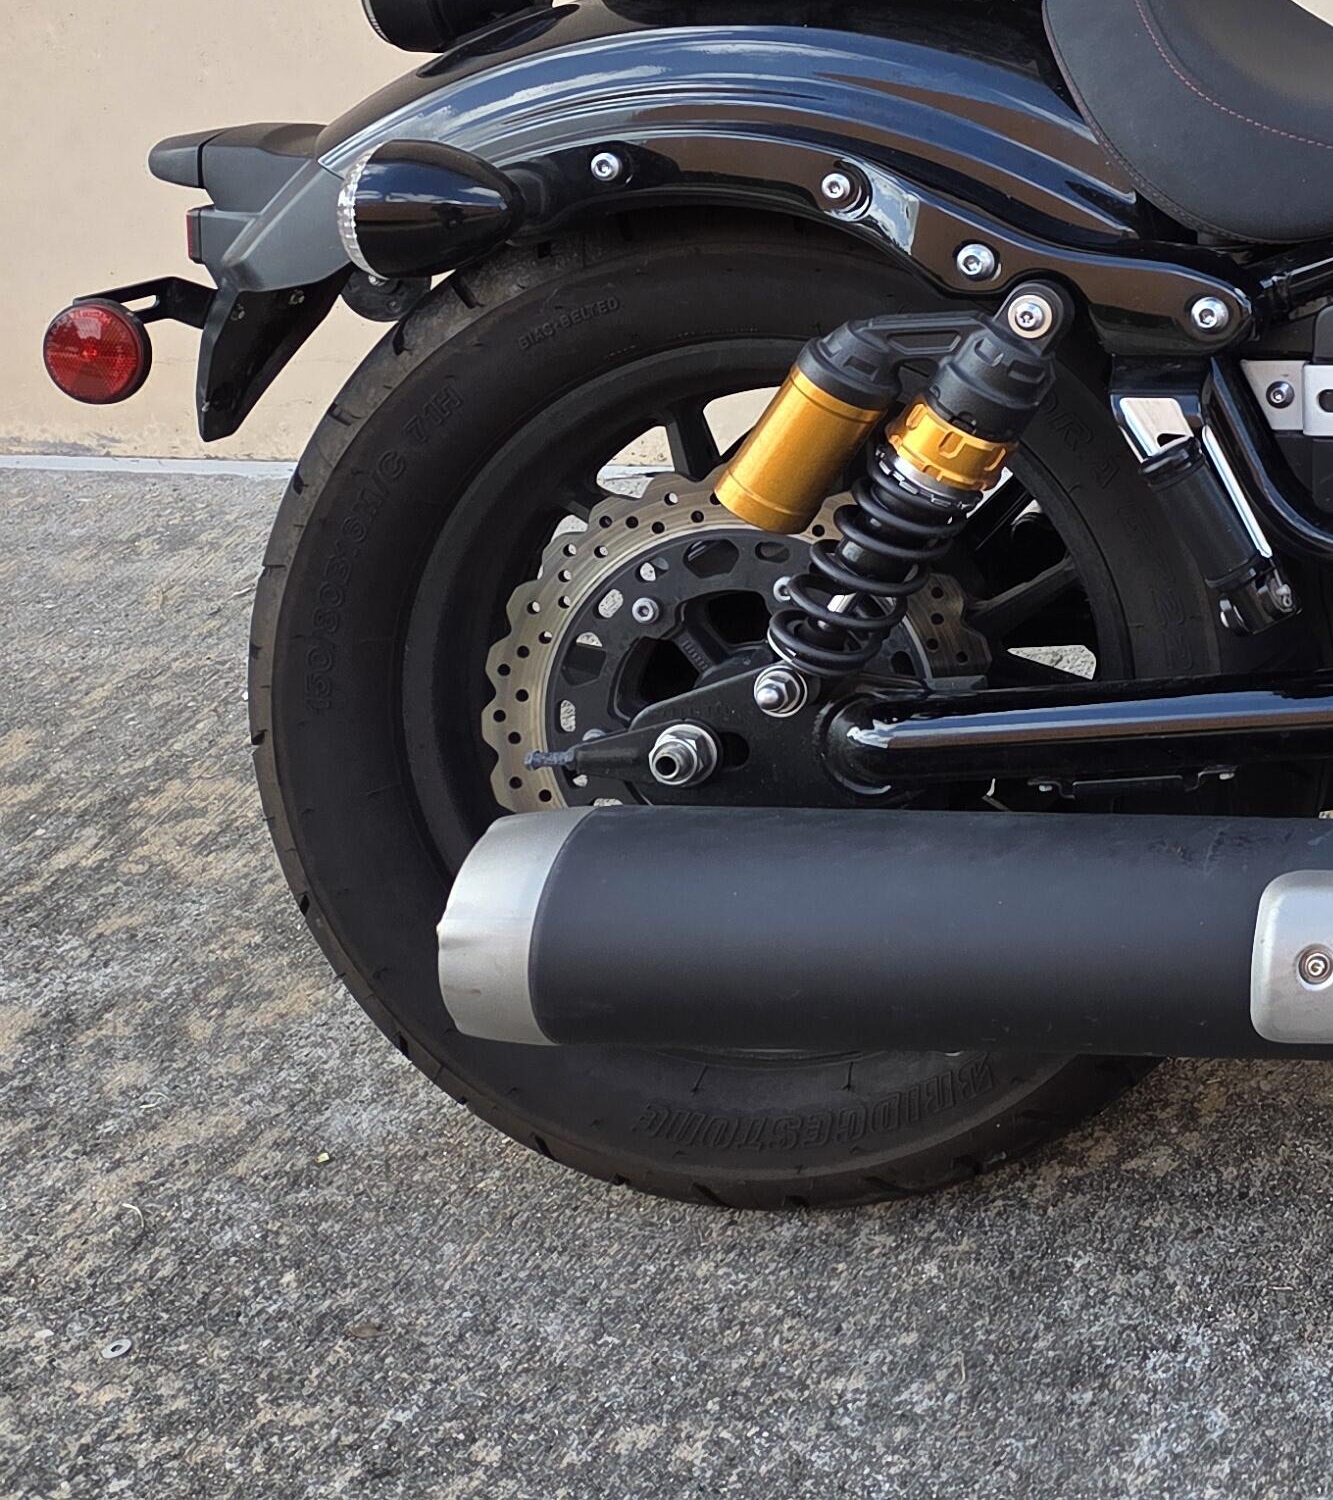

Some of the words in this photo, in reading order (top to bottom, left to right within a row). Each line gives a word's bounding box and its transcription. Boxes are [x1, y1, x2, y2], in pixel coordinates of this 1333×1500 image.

[516, 295, 622, 351] BIAS-BELTED
[404, 384, 465, 442] 71H
[629, 1051, 995, 1151] BRIDGESTONE
